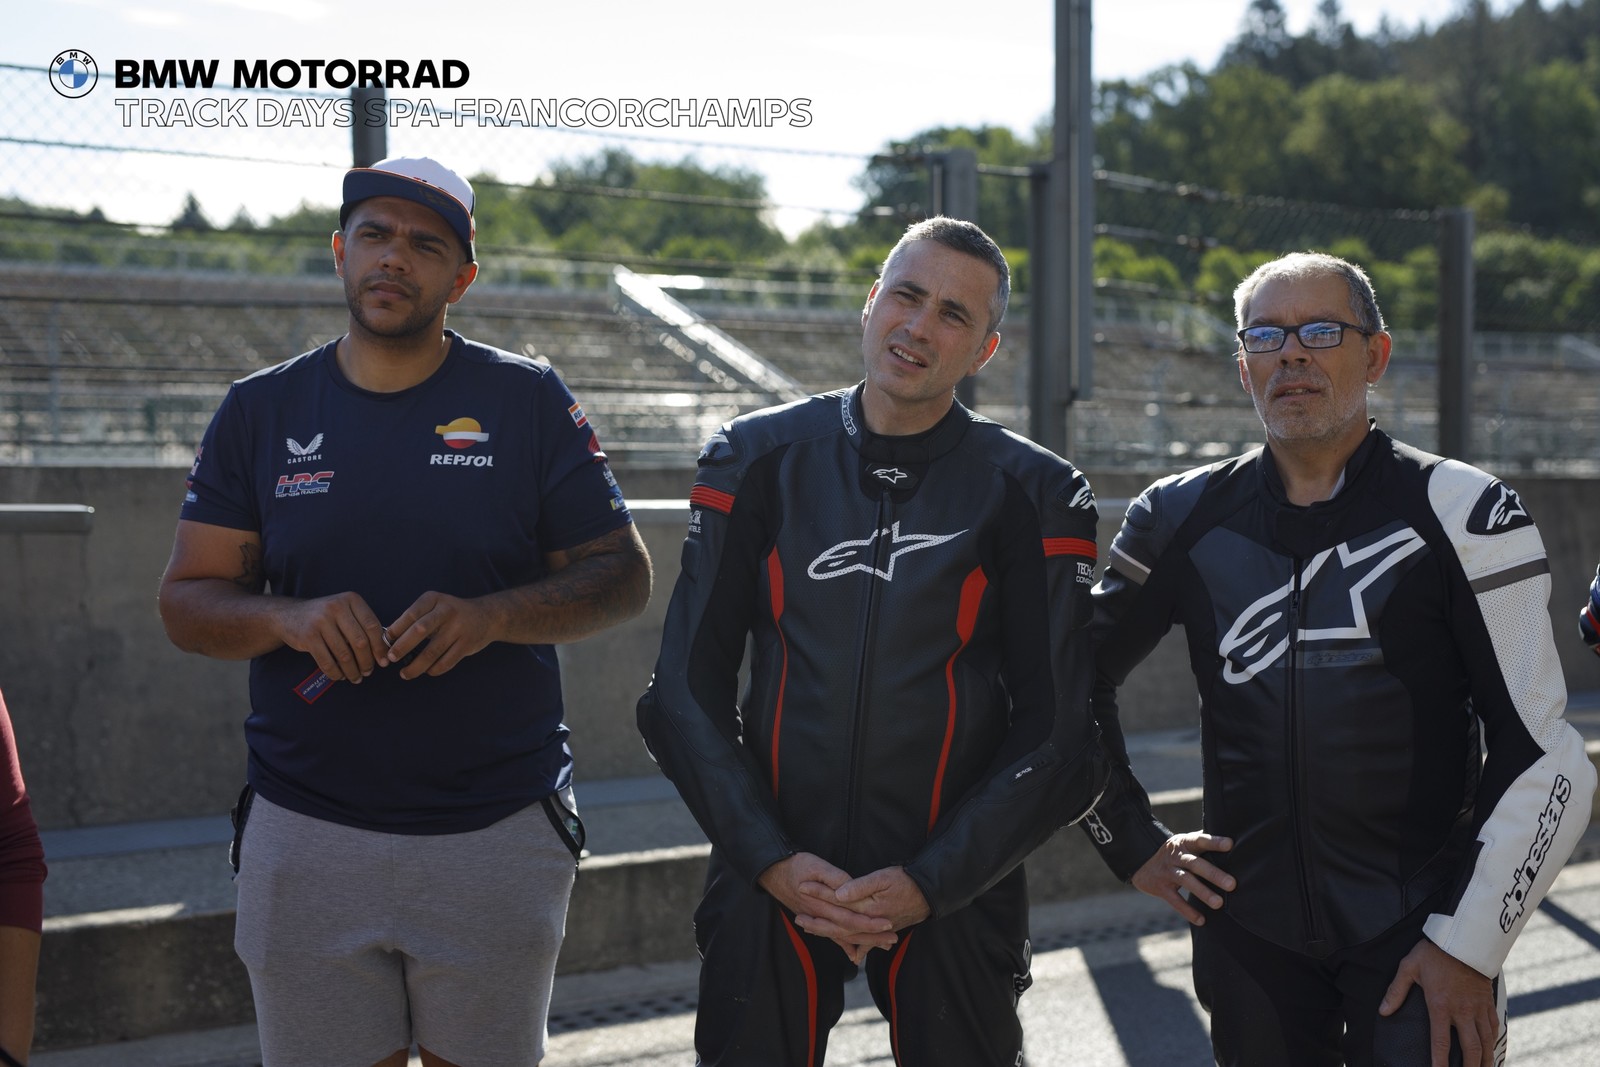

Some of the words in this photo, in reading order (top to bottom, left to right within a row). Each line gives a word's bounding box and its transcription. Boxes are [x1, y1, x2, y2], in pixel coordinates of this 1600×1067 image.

[287, 454, 322, 464] CASTORE
[430, 453, 494, 467] REPSOL
[275, 471, 335, 495] HRC
[1499, 774, 1572, 934] alpinestars
